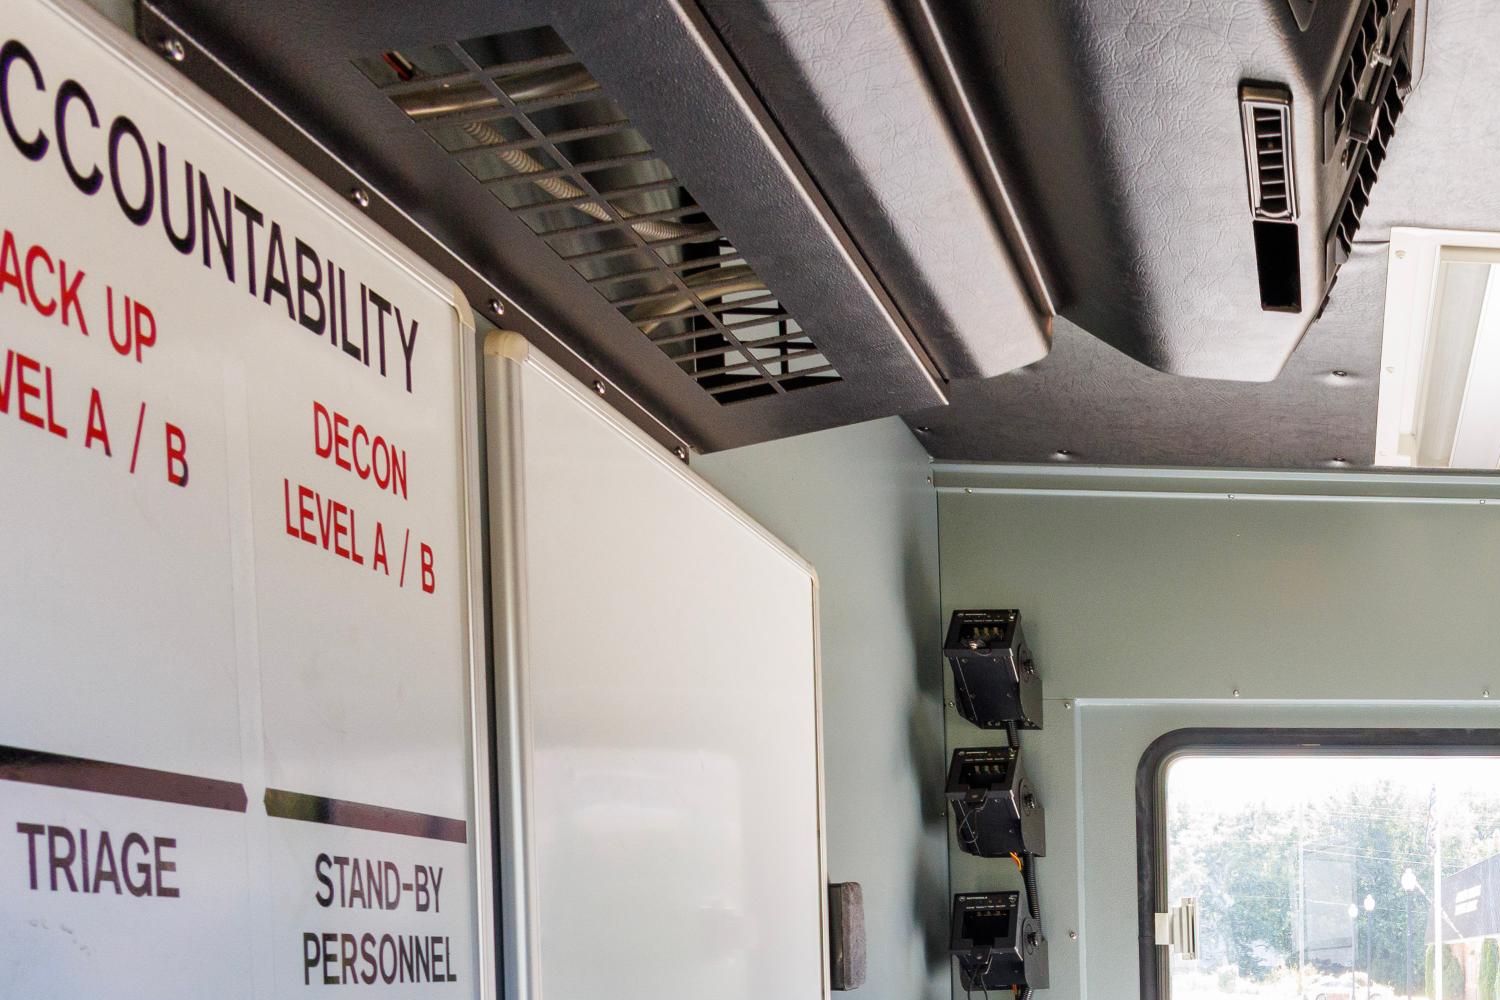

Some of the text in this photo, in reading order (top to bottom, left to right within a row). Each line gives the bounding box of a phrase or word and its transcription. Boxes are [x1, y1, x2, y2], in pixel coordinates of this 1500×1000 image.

[1, 39, 419, 393] CCOUNTABILITY
[0, 229, 157, 363] ACK UP
[84, 388, 112, 457] A
[129, 401, 147, 475] /
[165, 422, 189, 488] B
[312, 400, 408, 500] DECON
[284, 478, 436, 594] LEVEL A / B
[16, 822, 180, 898] TRIAGE
[314, 853, 444, 913] STAND-BY
[302, 932, 458, 986] PERSONNEL
